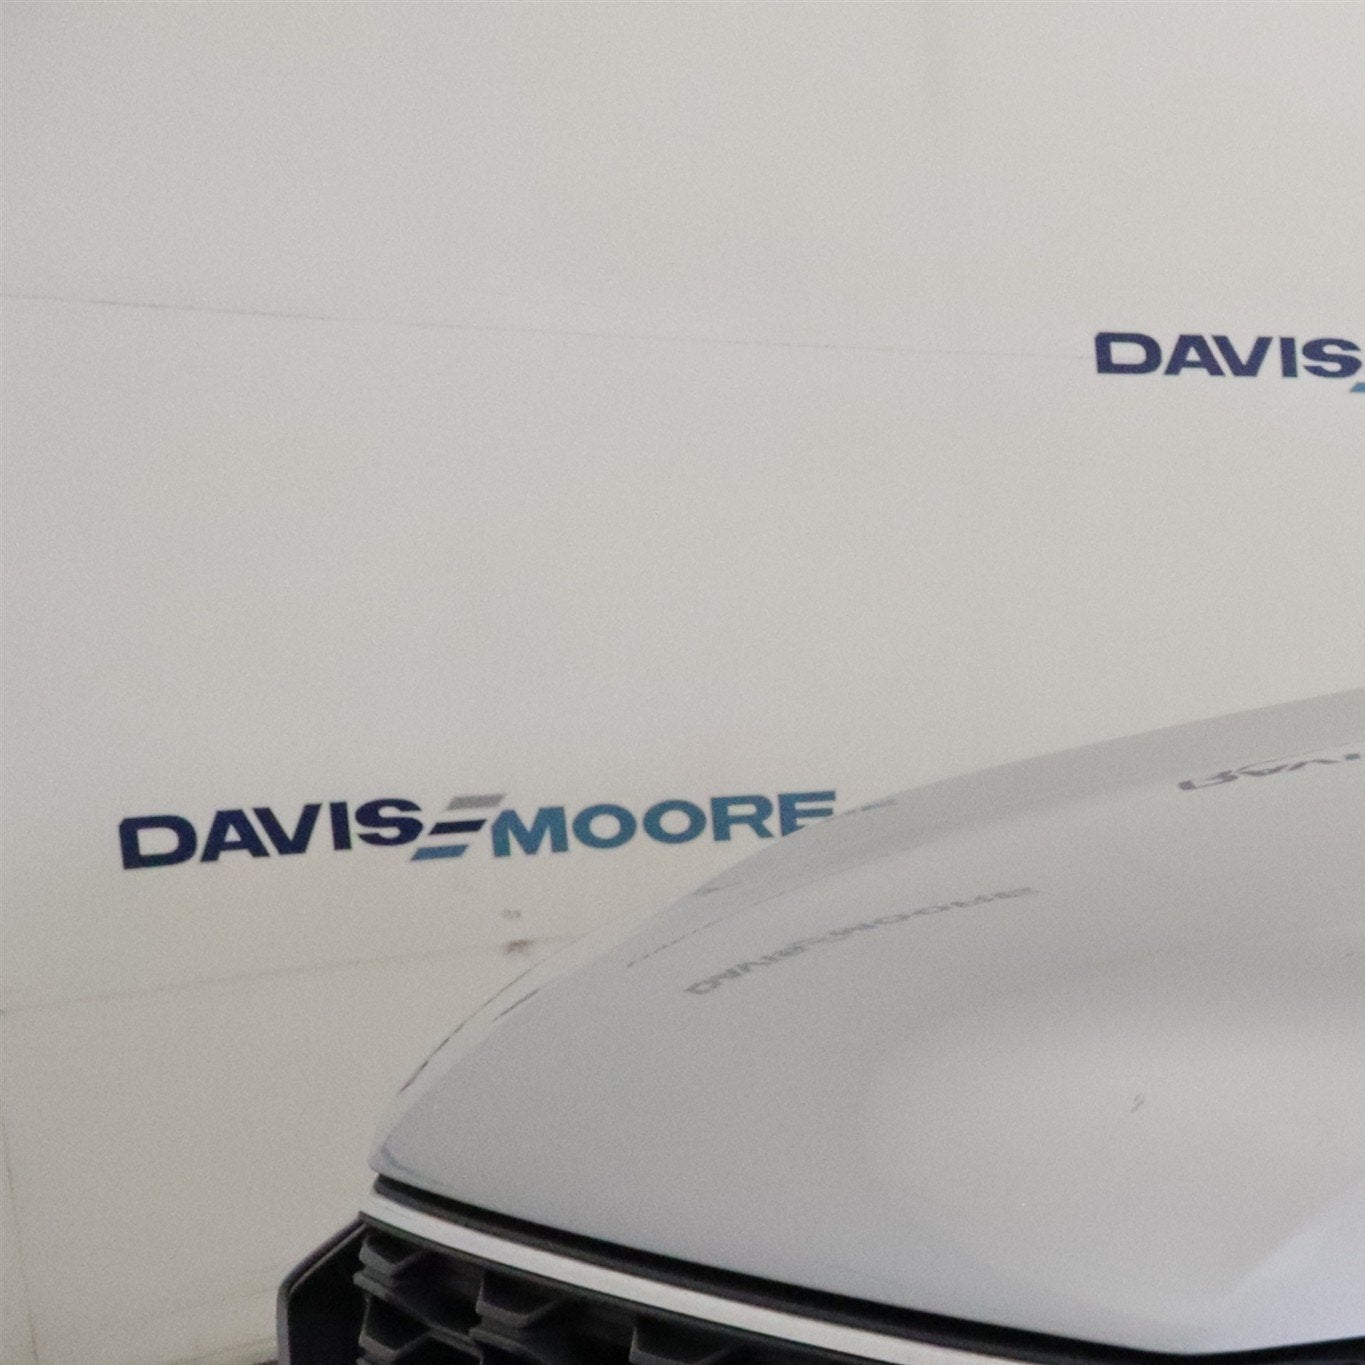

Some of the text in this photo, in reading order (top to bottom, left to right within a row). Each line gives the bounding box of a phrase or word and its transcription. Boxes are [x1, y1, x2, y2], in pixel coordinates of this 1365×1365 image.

[1094, 331, 1362, 378] DAVIS
[118, 790, 837, 870] DAVIS MOORE
